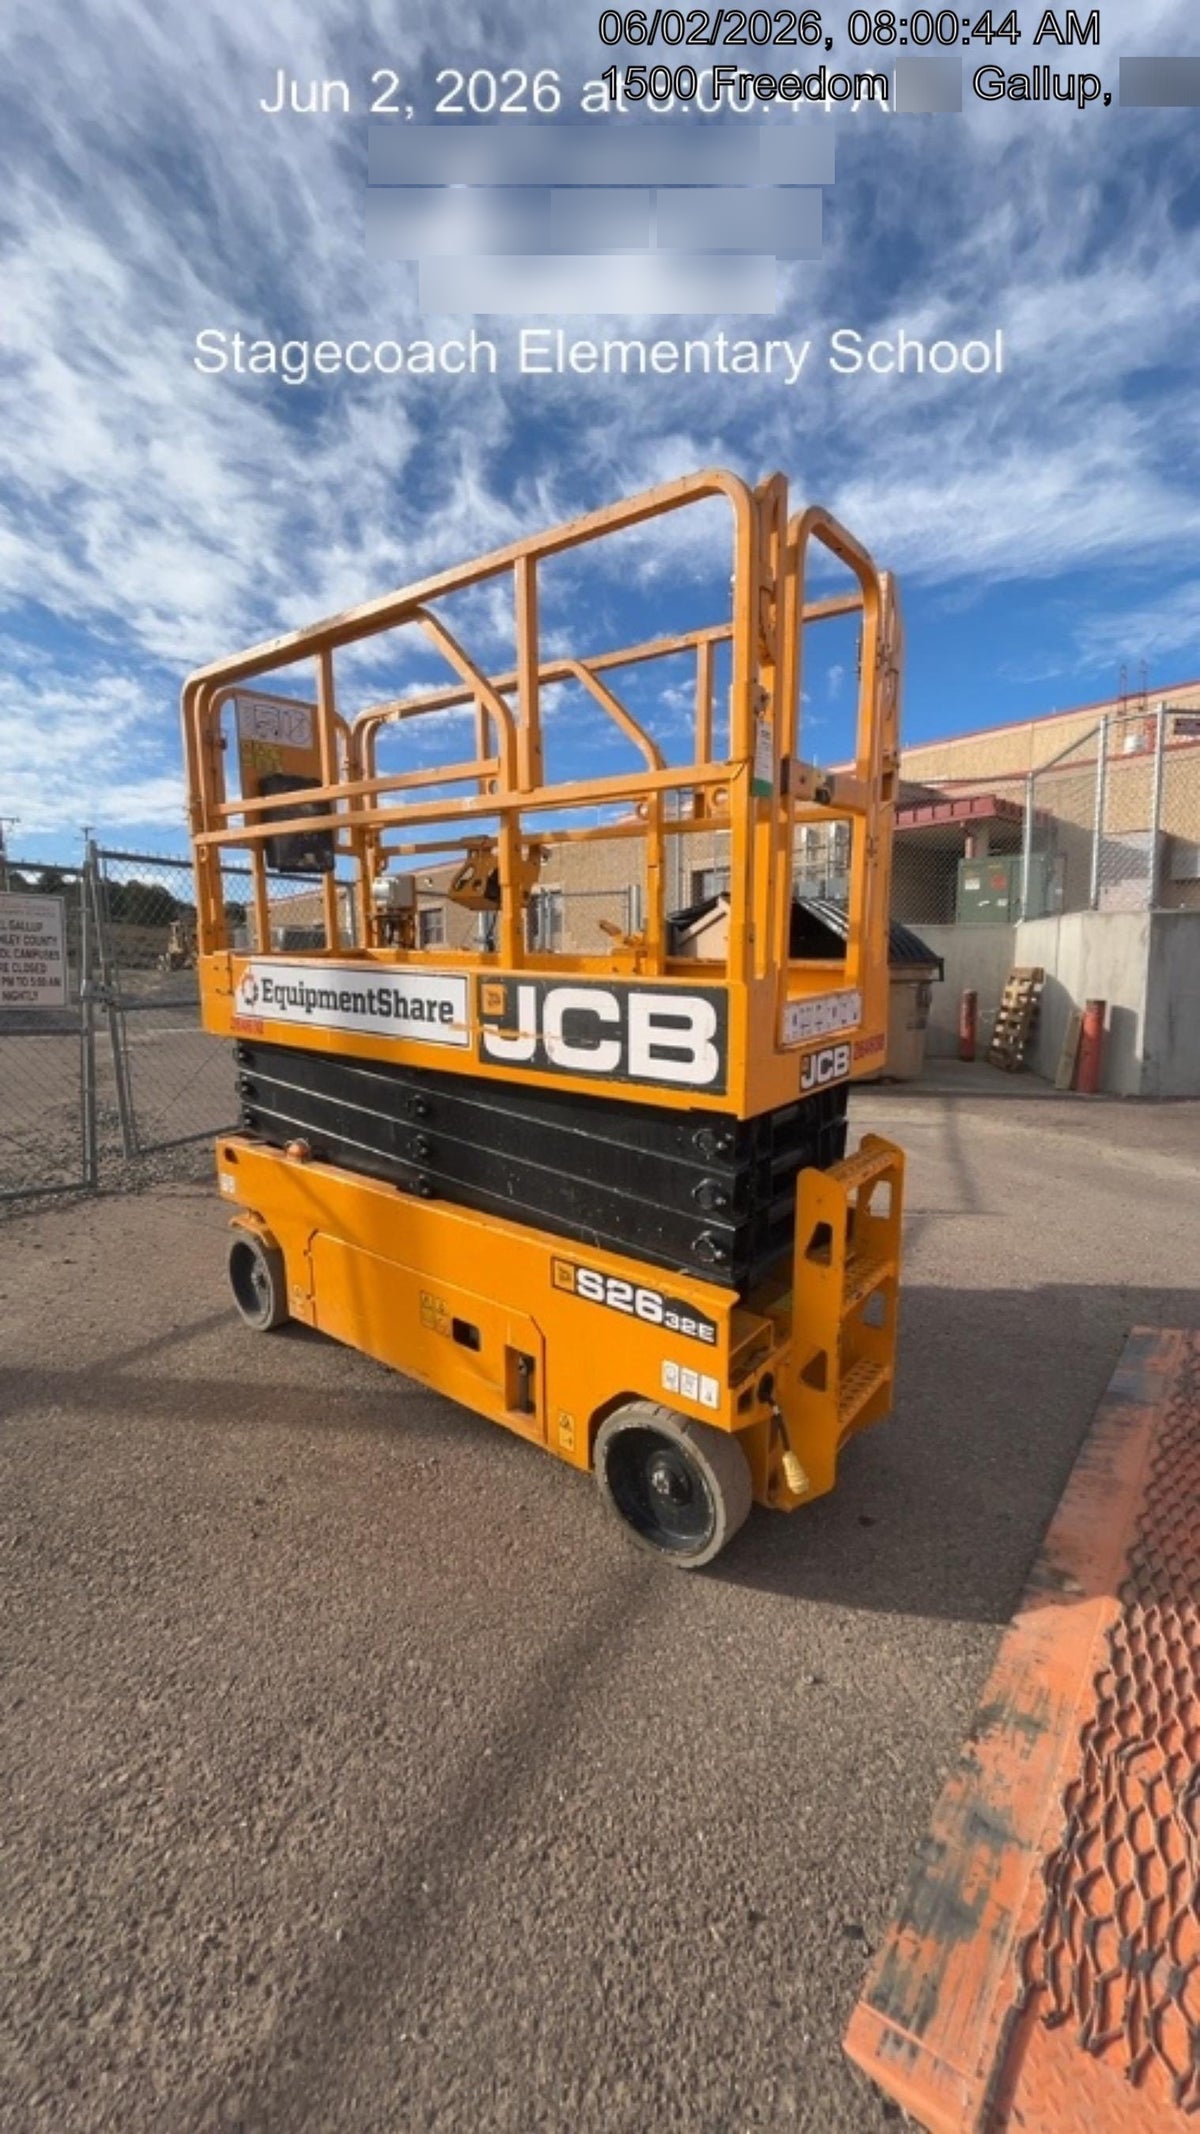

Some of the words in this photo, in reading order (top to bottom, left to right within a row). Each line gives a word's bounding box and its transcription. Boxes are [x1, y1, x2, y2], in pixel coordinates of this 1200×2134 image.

[260, 977, 454, 1024] EquipmentShare
[482, 984, 720, 1085] JCB
[800, 1044, 850, 1090] JCB
